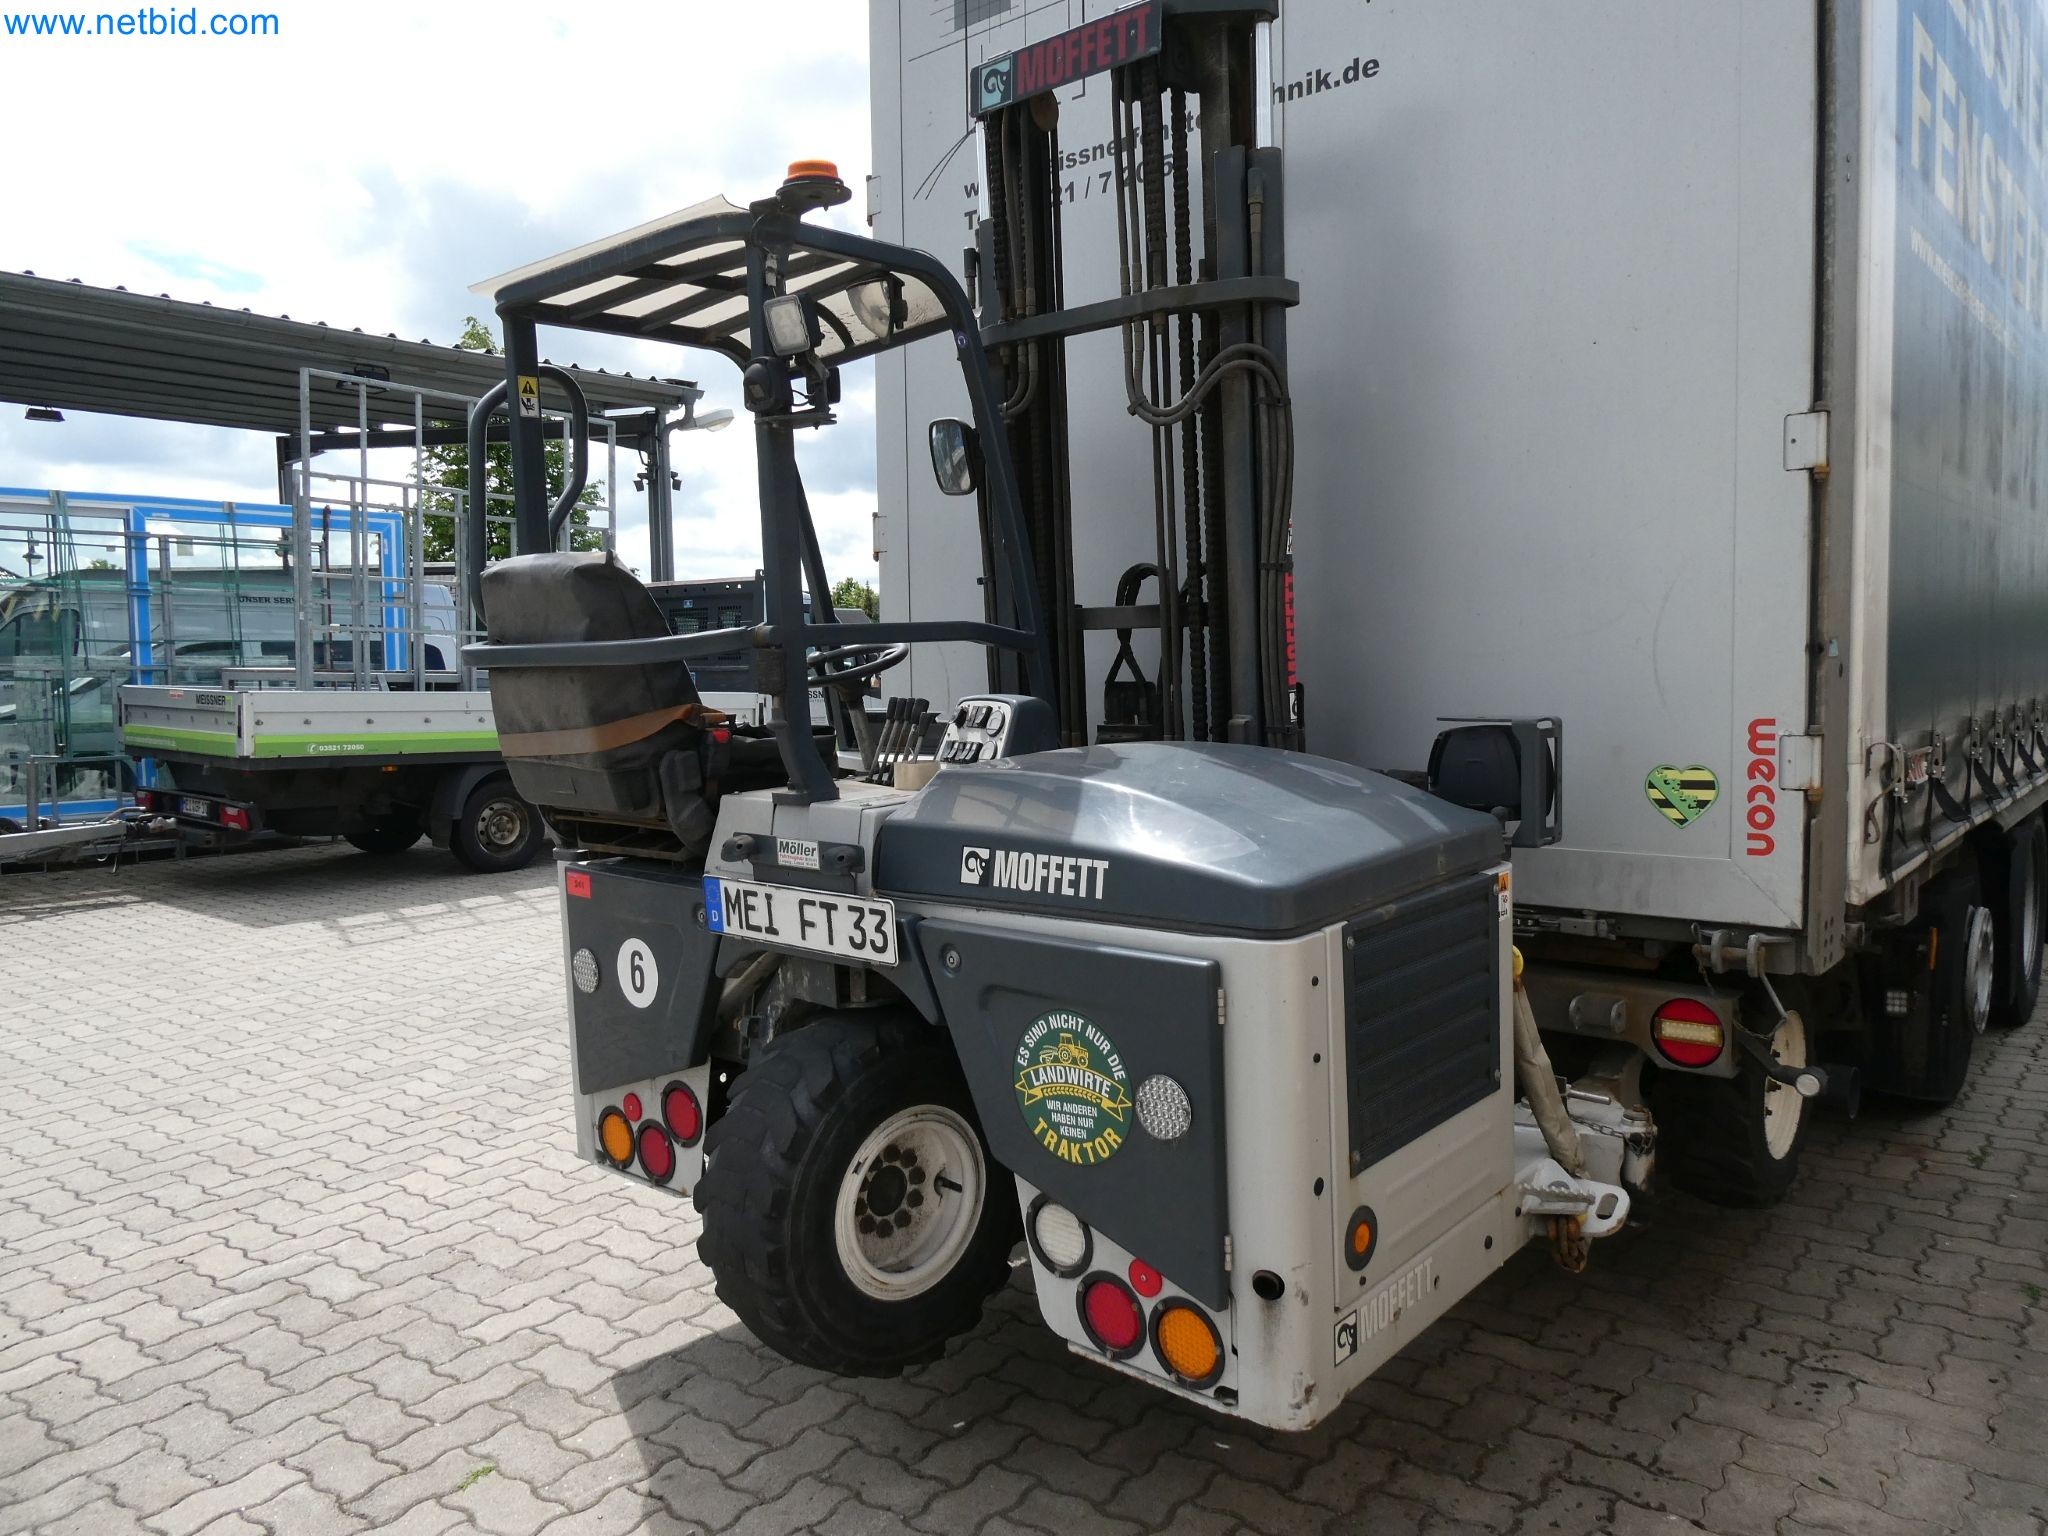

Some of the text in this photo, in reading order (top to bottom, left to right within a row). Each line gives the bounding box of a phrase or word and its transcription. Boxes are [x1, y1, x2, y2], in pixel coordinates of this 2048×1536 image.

[1017, 6, 1152, 96] MOFFETT
[1747, 718, 1776, 857] wecon
[779, 841, 816, 857] Möller
[993, 850, 1109, 900] MOFFETT
[711, 910, 719, 922] D
[724, 886, 889, 954] MEI FT 33
[630, 950, 645, 994] 6
[1017, 1013, 1126, 1081] ES SIND NICHT NUR DIE
[1030, 1065, 1112, 1098] LANDWIRTE
[1046, 1099, 1098, 1118] WIR ANDEREN
[1051, 1111, 1094, 1129] HABEN NUR
[1033, 1116, 1123, 1164] TRAKTOR
[1059, 1125, 1087, 1140] KEINEN
[1360, 1255, 1433, 1344] MOFFETT
